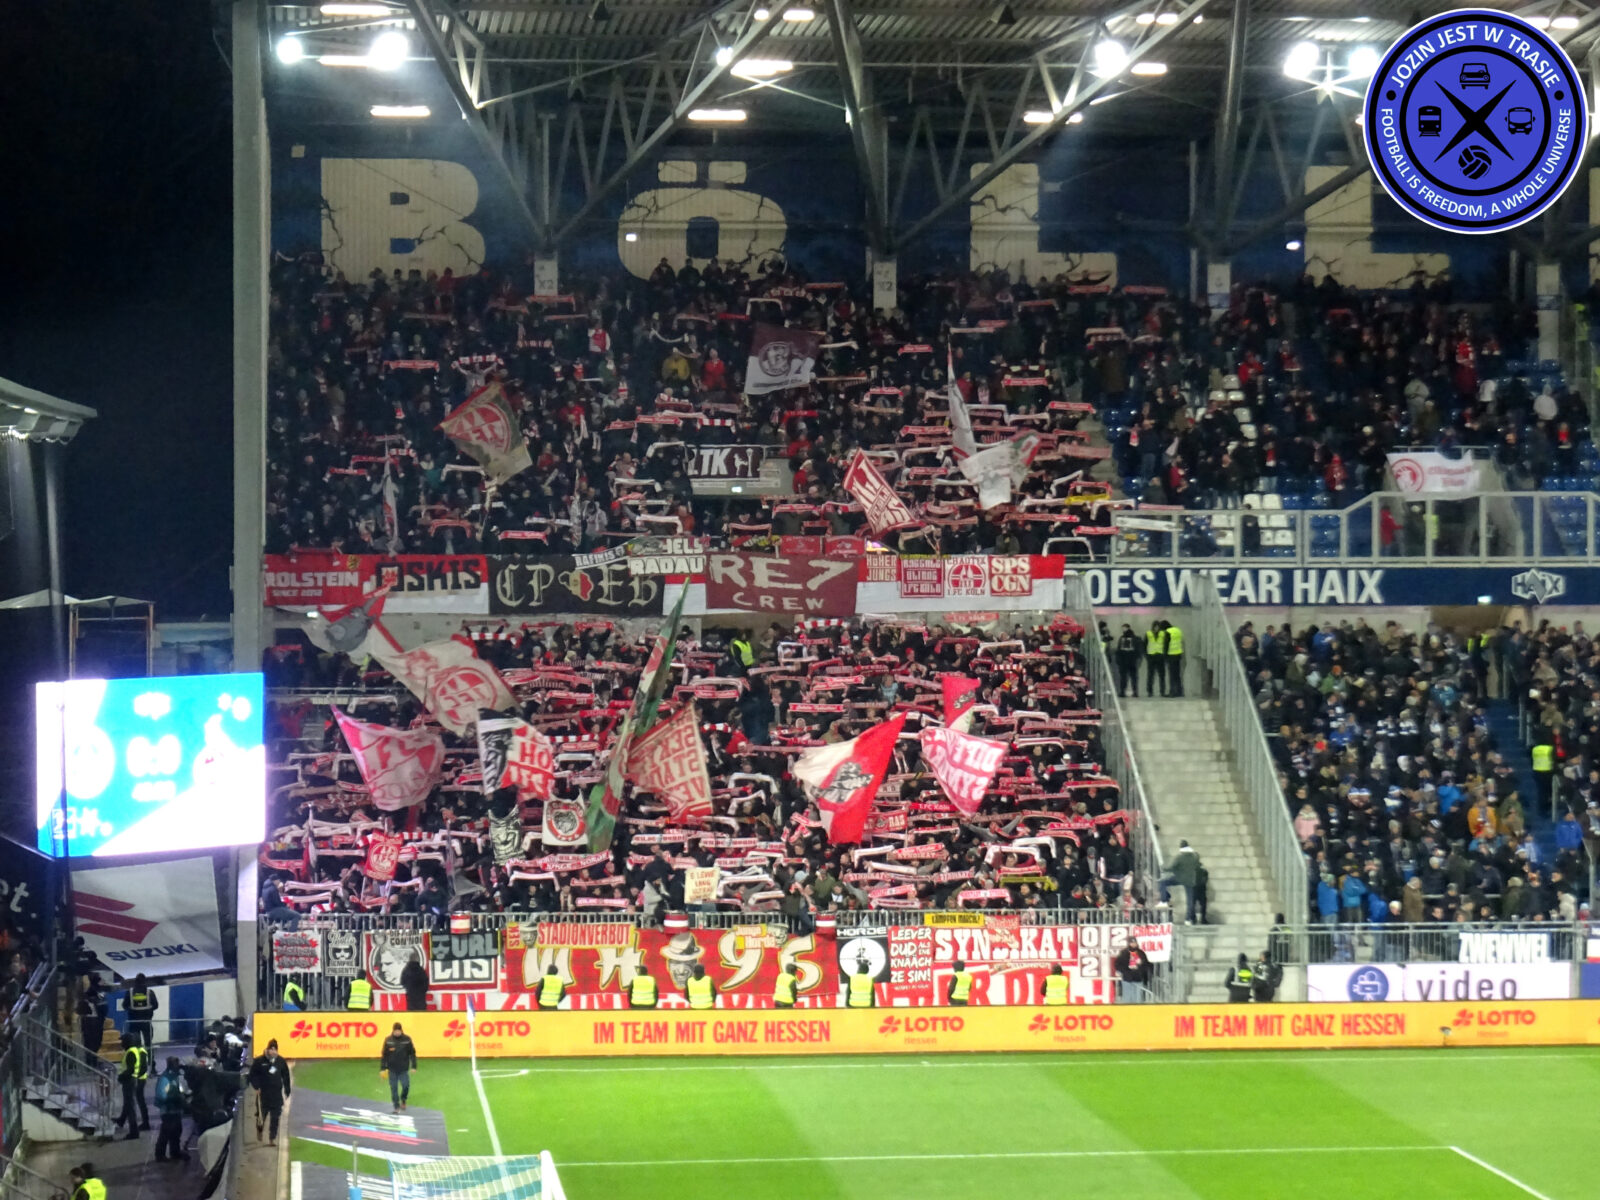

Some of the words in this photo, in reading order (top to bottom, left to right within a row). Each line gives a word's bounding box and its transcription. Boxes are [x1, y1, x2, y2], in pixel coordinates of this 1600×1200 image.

[630, 557, 704, 576] RADAU
[866, 568, 897, 581] JUNGS
[991, 558, 1030, 574] SPS
[991, 575, 1031, 592] CGN
[1064, 569, 1155, 604] OES
[1165, 569, 1287, 604] WEAR
[1294, 569, 1384, 604] HAIX
[733, 592, 824, 610] CREW
[537, 922, 631, 947] STADIONVERBOT
[836, 926, 887, 937] HORDE
[891, 928, 932, 941] LEEVER
[891, 941, 917, 957] DUD
[934, 926, 1075, 961] SYNKAT
[105, 943, 199, 962] SUZUKI
[891, 970, 905, 983] ZE
[908, 968, 931, 983] SIN!
[1417, 970, 1518, 1001] video
[904, 1016, 964, 1032] LOTTO
[1053, 1014, 1114, 1031] LOTTO
[1174, 1017, 1195, 1037] IM
[1202, 1016, 1247, 1036] TEAM
[1254, 1015, 1284, 1036] MIT
[1291, 1015, 1335, 1036] GANZ
[1341, 1013, 1405, 1035] HESSEN
[1477, 1009, 1536, 1026] LOTTO
[316, 1022, 377, 1038] LOTTO
[594, 1022, 614, 1044] IM
[621, 1021, 668, 1043] TEAM
[675, 1021, 707, 1043] MIT
[713, 1021, 759, 1043] GANZ
[764, 1020, 831, 1042] HESSEN
[316, 1041, 350, 1050] Hessen
